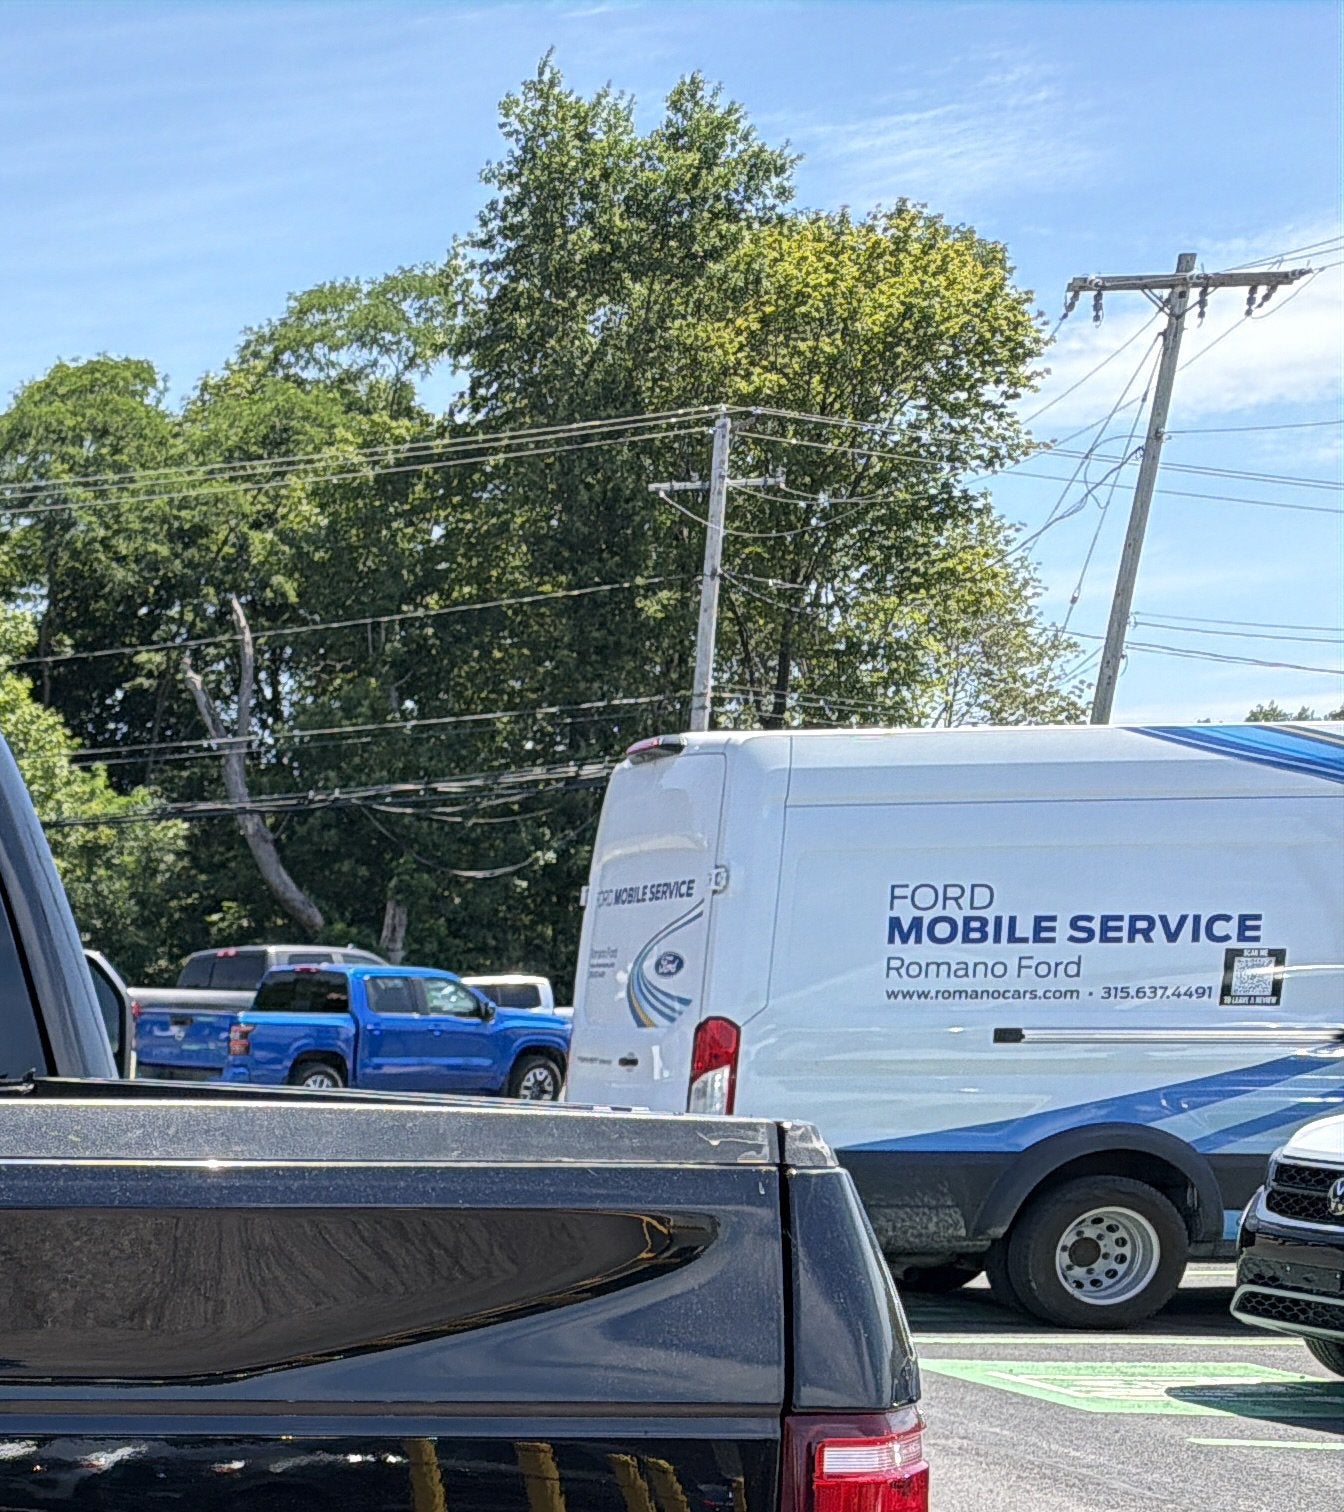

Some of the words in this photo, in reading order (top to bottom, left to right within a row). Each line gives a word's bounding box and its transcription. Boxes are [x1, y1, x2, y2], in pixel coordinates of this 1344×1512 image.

[614, 885, 648, 905] MOBILE
[649, 879, 695, 902] SERVICE
[888, 883, 995, 911] FORD
[887, 915, 1058, 944] MOBILE
[1067, 914, 1263, 943] SERVICE
[885, 956, 1008, 979] Romano
[1016, 955, 1082, 979] Ford
[885, 986, 1080, 1001] www.romanocars.com
[1100, 985, 1213, 1000] 315.637.4491
